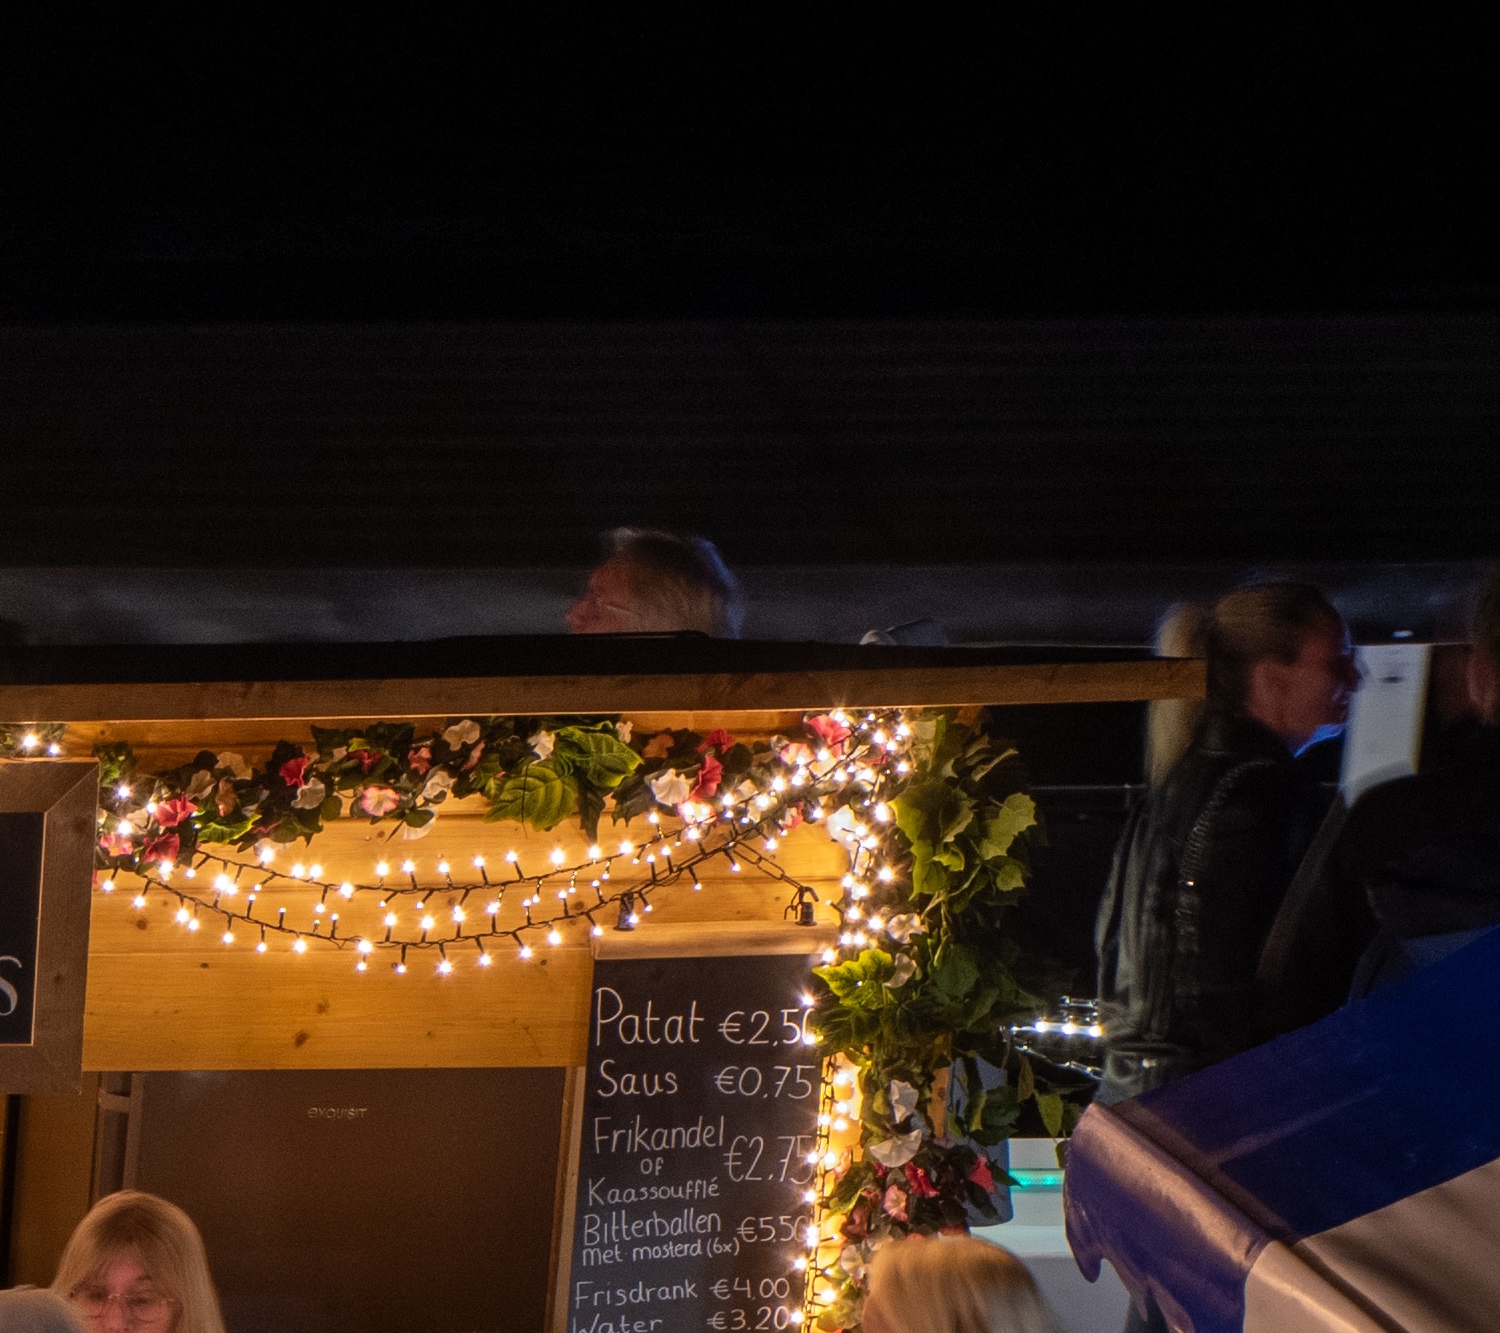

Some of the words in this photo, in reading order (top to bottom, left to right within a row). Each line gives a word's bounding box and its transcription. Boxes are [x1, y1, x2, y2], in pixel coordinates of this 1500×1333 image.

[595, 986, 705, 1046] Patat
[597, 1059, 679, 1097] Saus
[594, 1113, 725, 1155] Frikandel
[640, 1156, 665, 1176] of
[587, 1176, 721, 1207] Kaassoufflé
[582, 1207, 722, 1247] Bitterballen
[581, 1243, 623, 1267] met
[632, 1239, 702, 1262] mosterd
[706, 1236, 740, 1259] (6x)
[574, 1278, 699, 1310] Frisdrank
